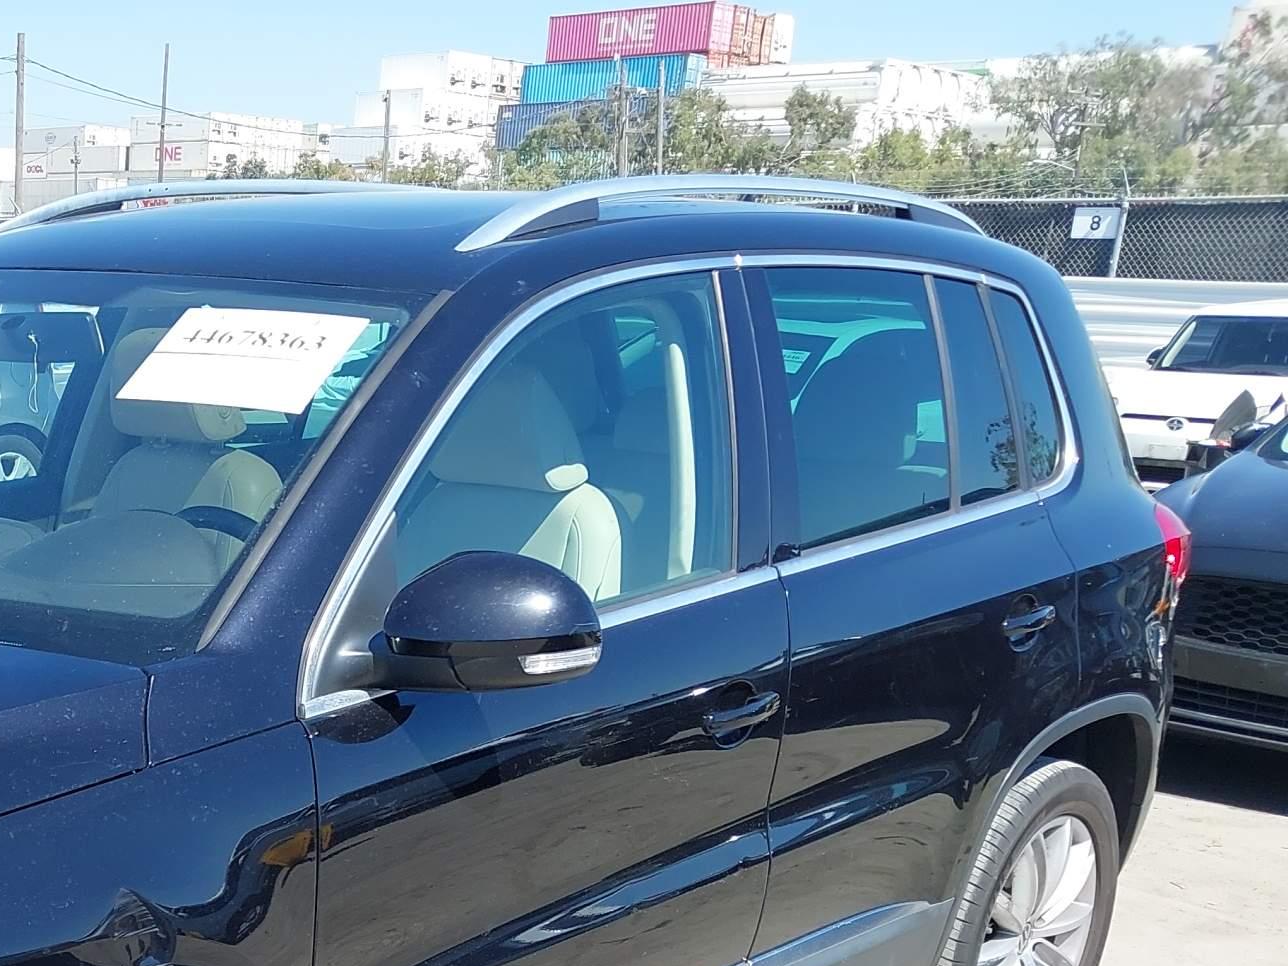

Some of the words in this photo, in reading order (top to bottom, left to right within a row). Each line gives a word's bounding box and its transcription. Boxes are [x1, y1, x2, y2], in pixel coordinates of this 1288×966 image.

[599, 13, 656, 45] ONE
[1090, 215, 1101, 231] 8
[183, 328, 327, 351] 44678363
